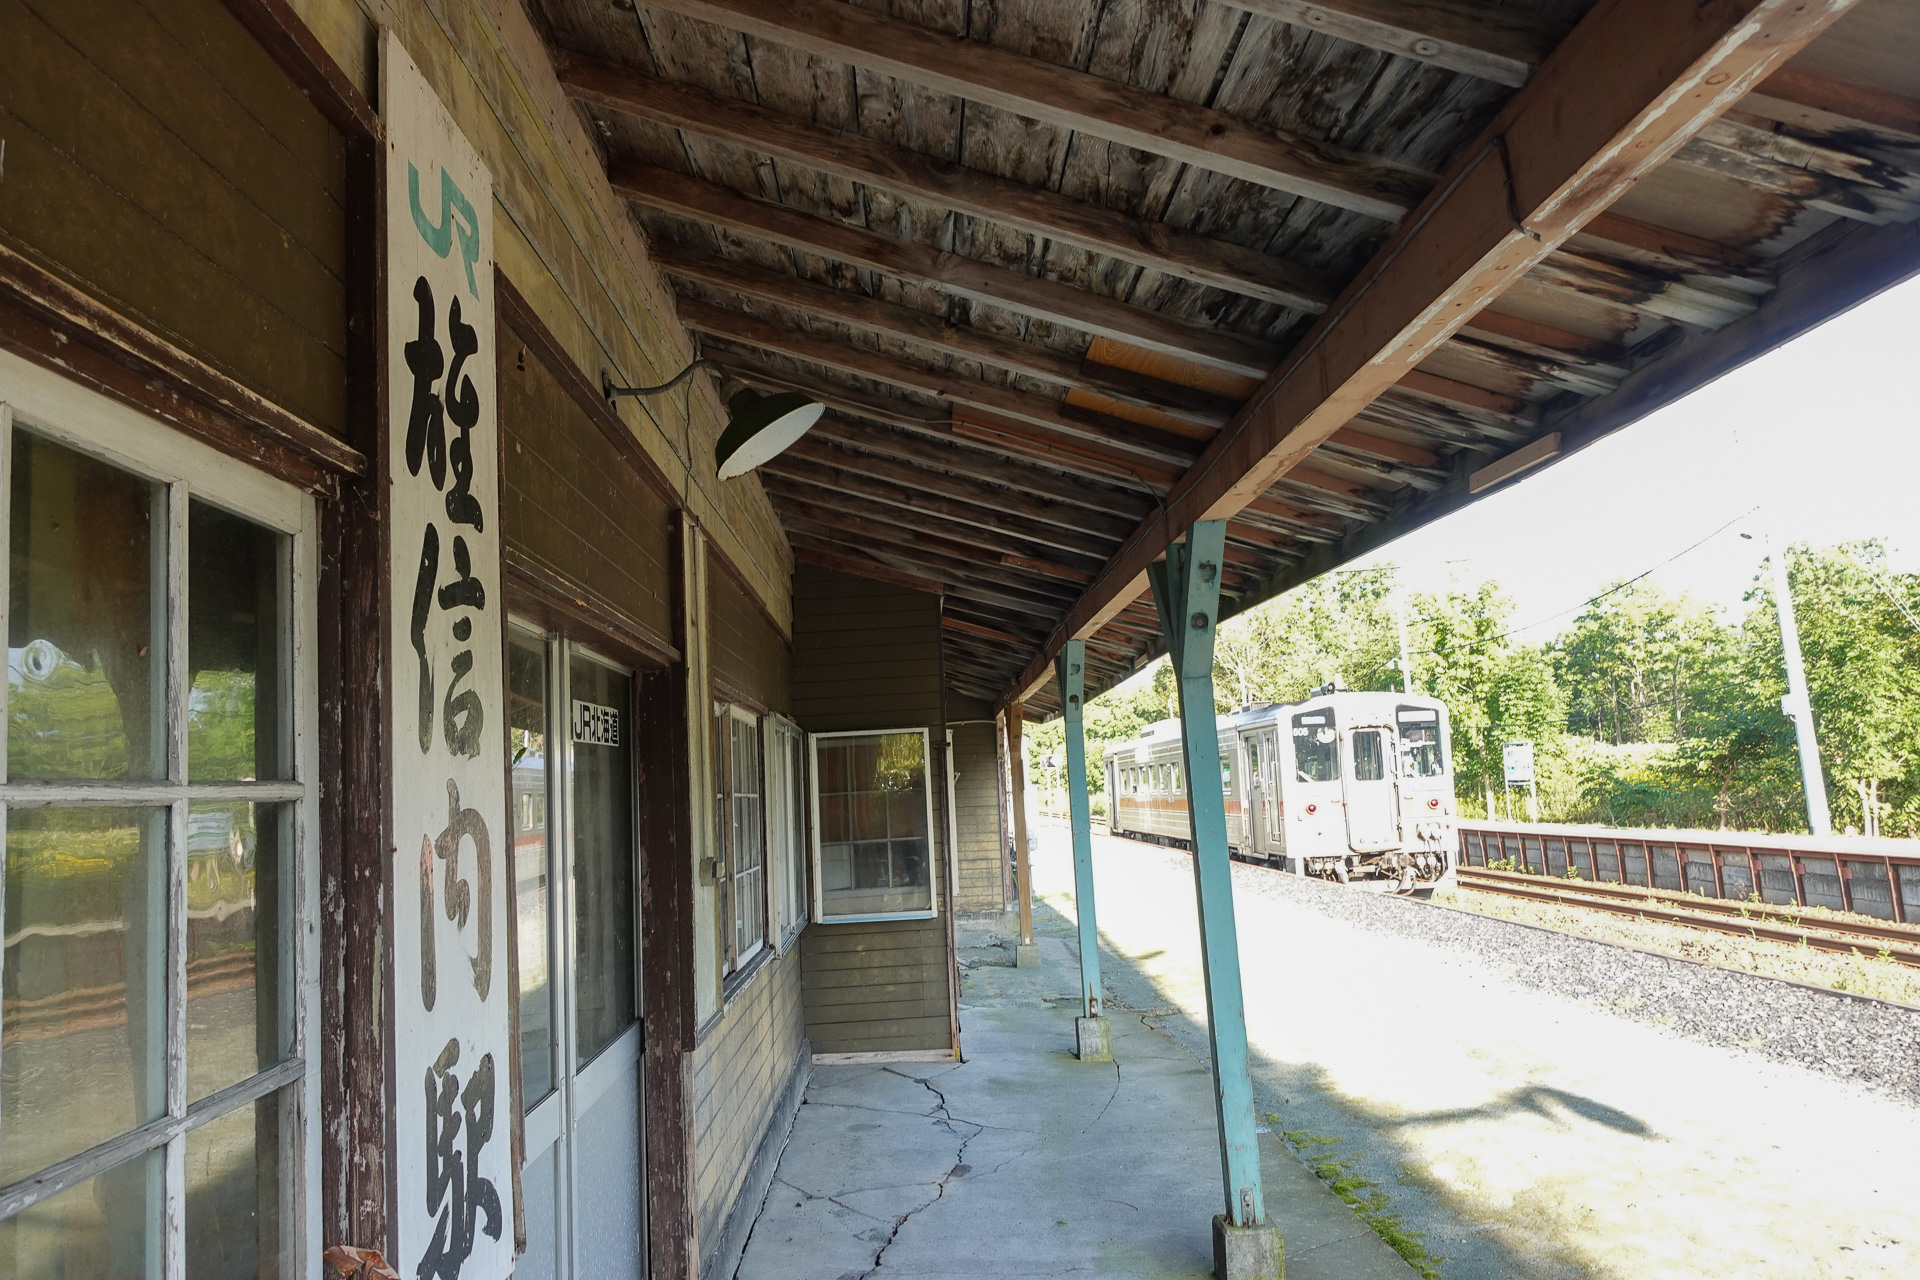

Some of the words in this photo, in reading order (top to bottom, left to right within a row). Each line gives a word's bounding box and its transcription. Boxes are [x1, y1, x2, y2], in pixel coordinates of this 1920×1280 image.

[408, 159, 480, 302] JR
[574, 703, 619, 745] JR北海道
